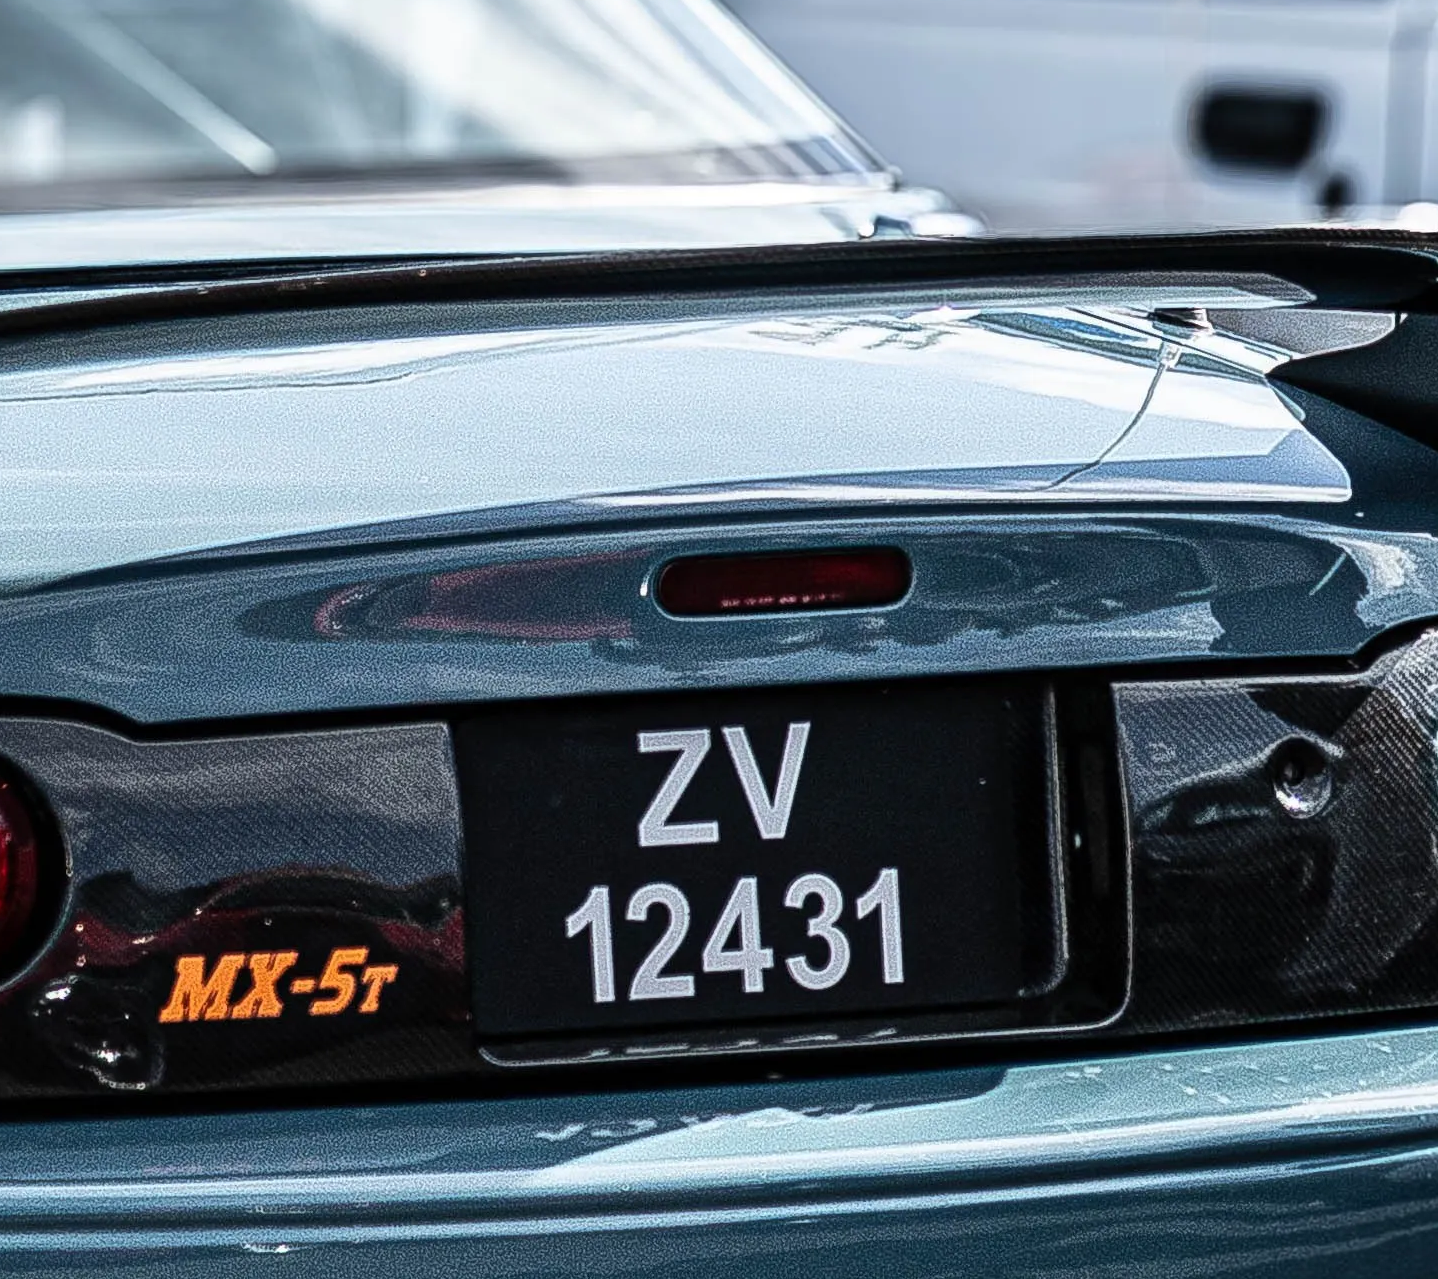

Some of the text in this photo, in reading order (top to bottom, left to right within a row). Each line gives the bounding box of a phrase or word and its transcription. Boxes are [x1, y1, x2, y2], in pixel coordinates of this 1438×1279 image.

[637, 721, 810, 847] ZV
[158, 945, 399, 1023] MX-5T
[565, 867, 904, 1003] 12431
